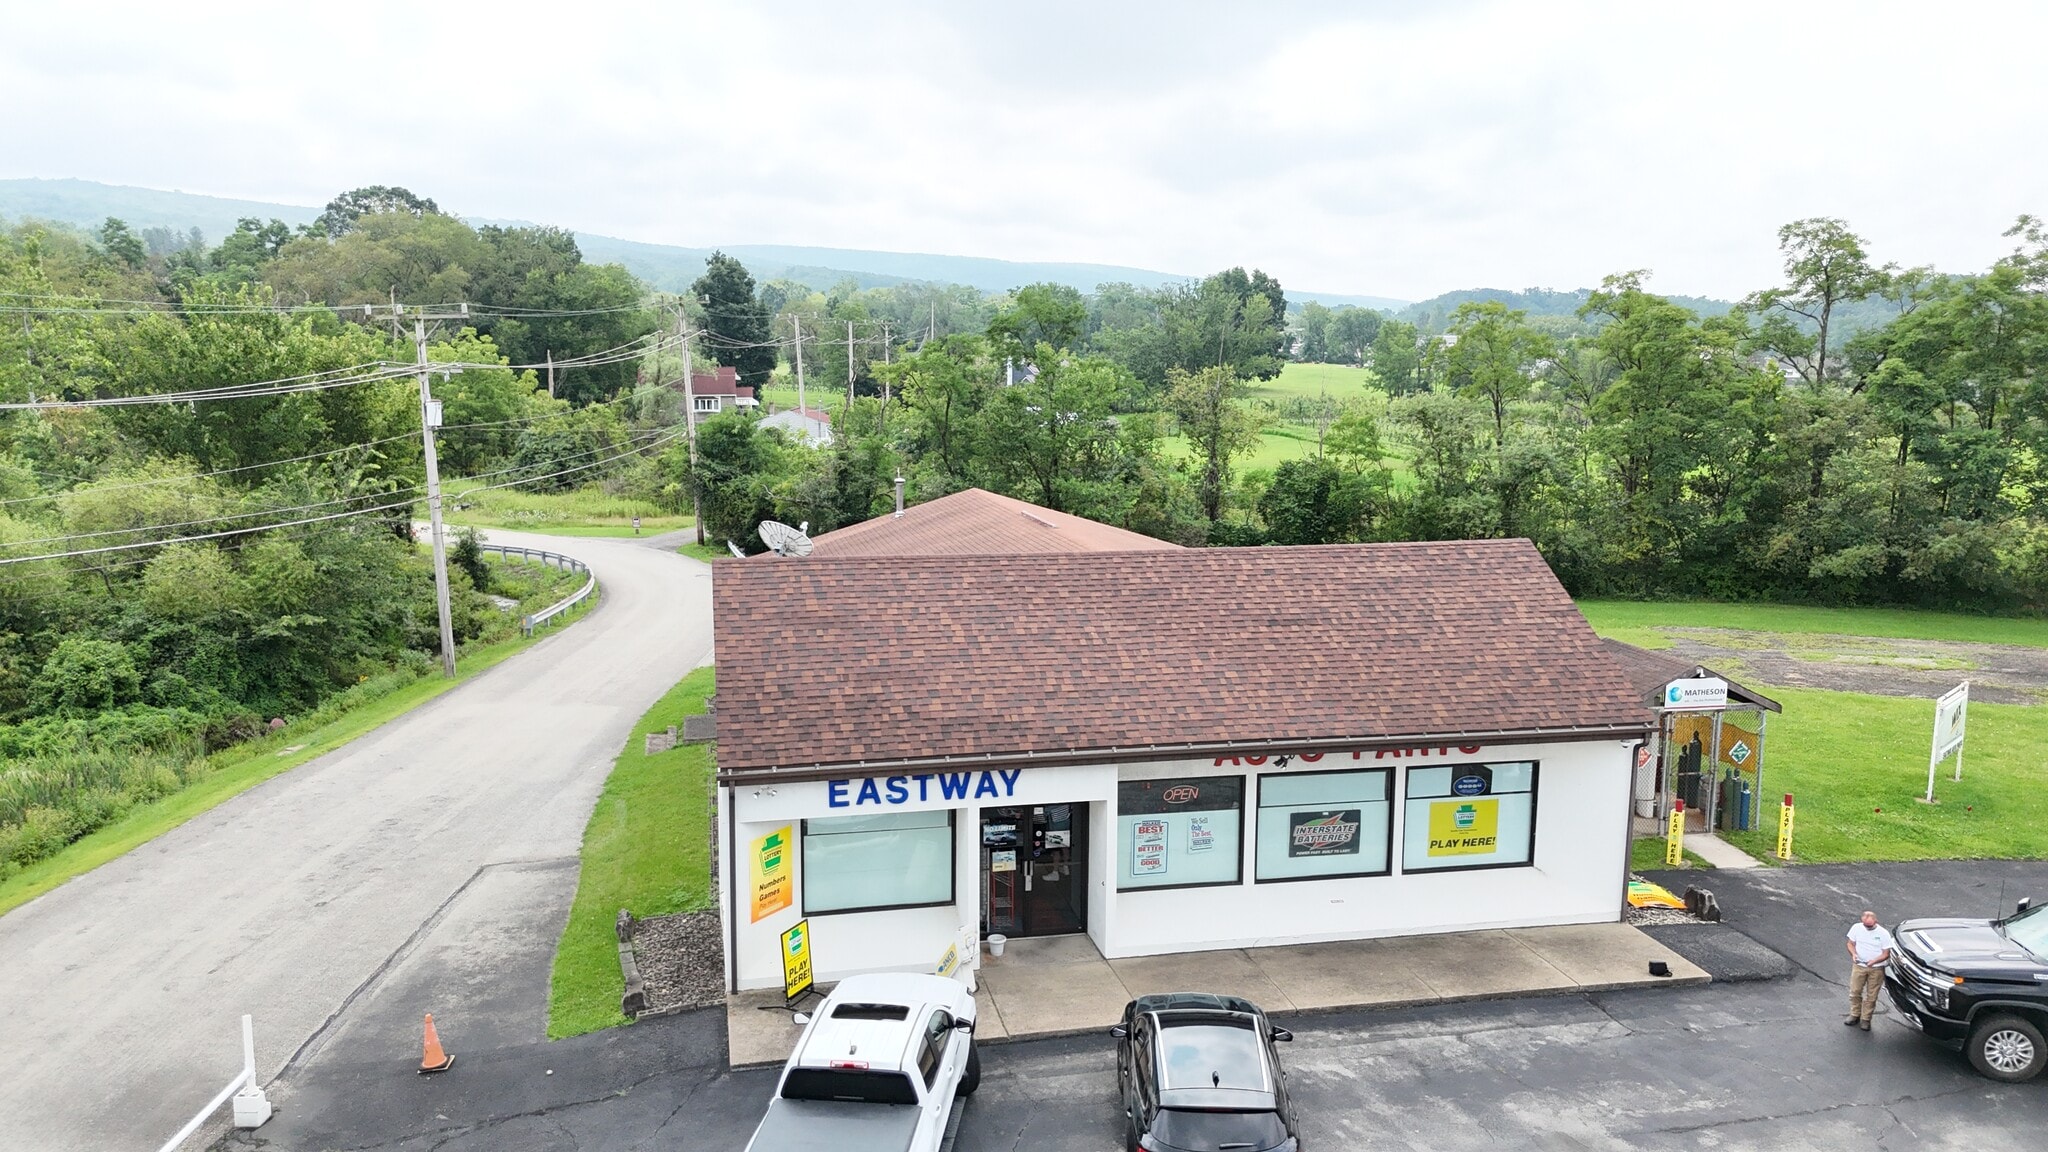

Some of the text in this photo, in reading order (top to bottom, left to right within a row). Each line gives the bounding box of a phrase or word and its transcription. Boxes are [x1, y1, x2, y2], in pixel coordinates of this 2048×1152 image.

[1684, 688, 1725, 696] MATHESON
[828, 769, 1021, 808] EASTWAY
[1163, 787, 1199, 801] OPEN
[1138, 826, 1163, 834] BEST
[1296, 824, 1355, 835] INTERSTATE
[1297, 833, 1350, 843] BATTERIES
[1429, 836, 1496, 849] PLAY HERE!
[764, 849, 782, 861] LOTTERY
[759, 875, 786, 891] Numbers
[759, 888, 780, 901] Games
[789, 958, 808, 978] PLAY
[788, 968, 810, 990] HERE!
